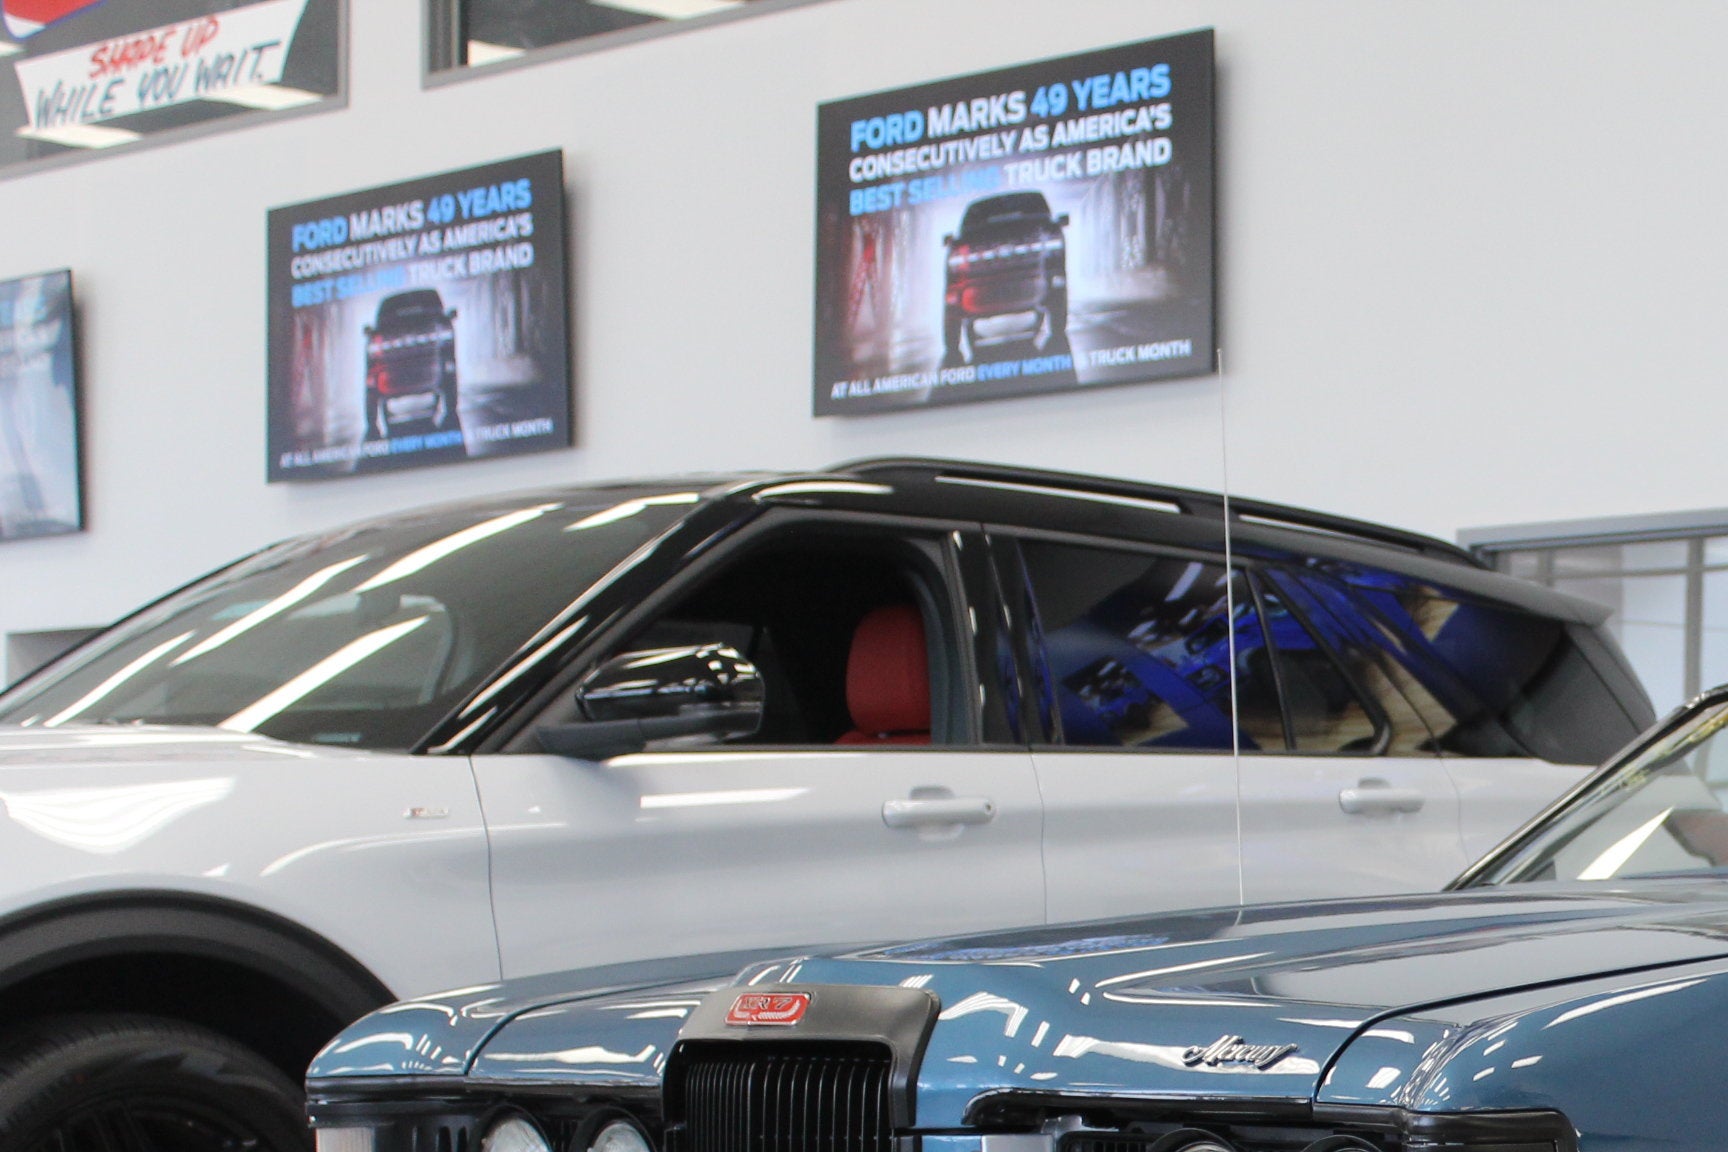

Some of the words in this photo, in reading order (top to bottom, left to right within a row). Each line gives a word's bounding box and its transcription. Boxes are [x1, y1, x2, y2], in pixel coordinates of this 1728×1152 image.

[181, 15, 220, 57] UP
[35, 78, 124, 128] WHILE
[137, 62, 188, 105] YOU
[851, 110, 924, 152] FORD
[927, 91, 1027, 138] MARKS
[1030, 82, 1068, 118] 49
[1071, 63, 1171, 111] YEARS
[850, 130, 1017, 183] CONSECUTIVELY
[1018, 124, 1049, 152] AS
[1051, 103, 1172, 147] AMERICA'S
[850, 181, 906, 216] BEST
[1004, 150, 1083, 185] TRUCK
[1086, 137, 1172, 175] BRAND
[291, 234, 418, 279] CONSECUTIVELY
[418, 229, 442, 255] AS
[443, 212, 533, 250] AMERICA'S
[292, 216, 348, 253] FORD
[350, 200, 424, 241] MARKS
[427, 195, 455, 224] 49
[458, 178, 532, 219] YEARS
[292, 279, 334, 308] BEST
[408, 254, 467, 285] TRUCK
[468, 242, 534, 275] BRAND
[831, 381, 848, 398] AT
[848, 379, 871, 397] ALL
[872, 371, 938, 394] AMERICAN
[940, 365, 976, 385] FORD
[977, 359, 1021, 381] EVERY
[1022, 354, 1072, 376] MONTH
[1090, 348, 1137, 368] TRUCK
[1138, 339, 1192, 363] MONTH
[1182, 1034, 1298, 1067] Mercury
